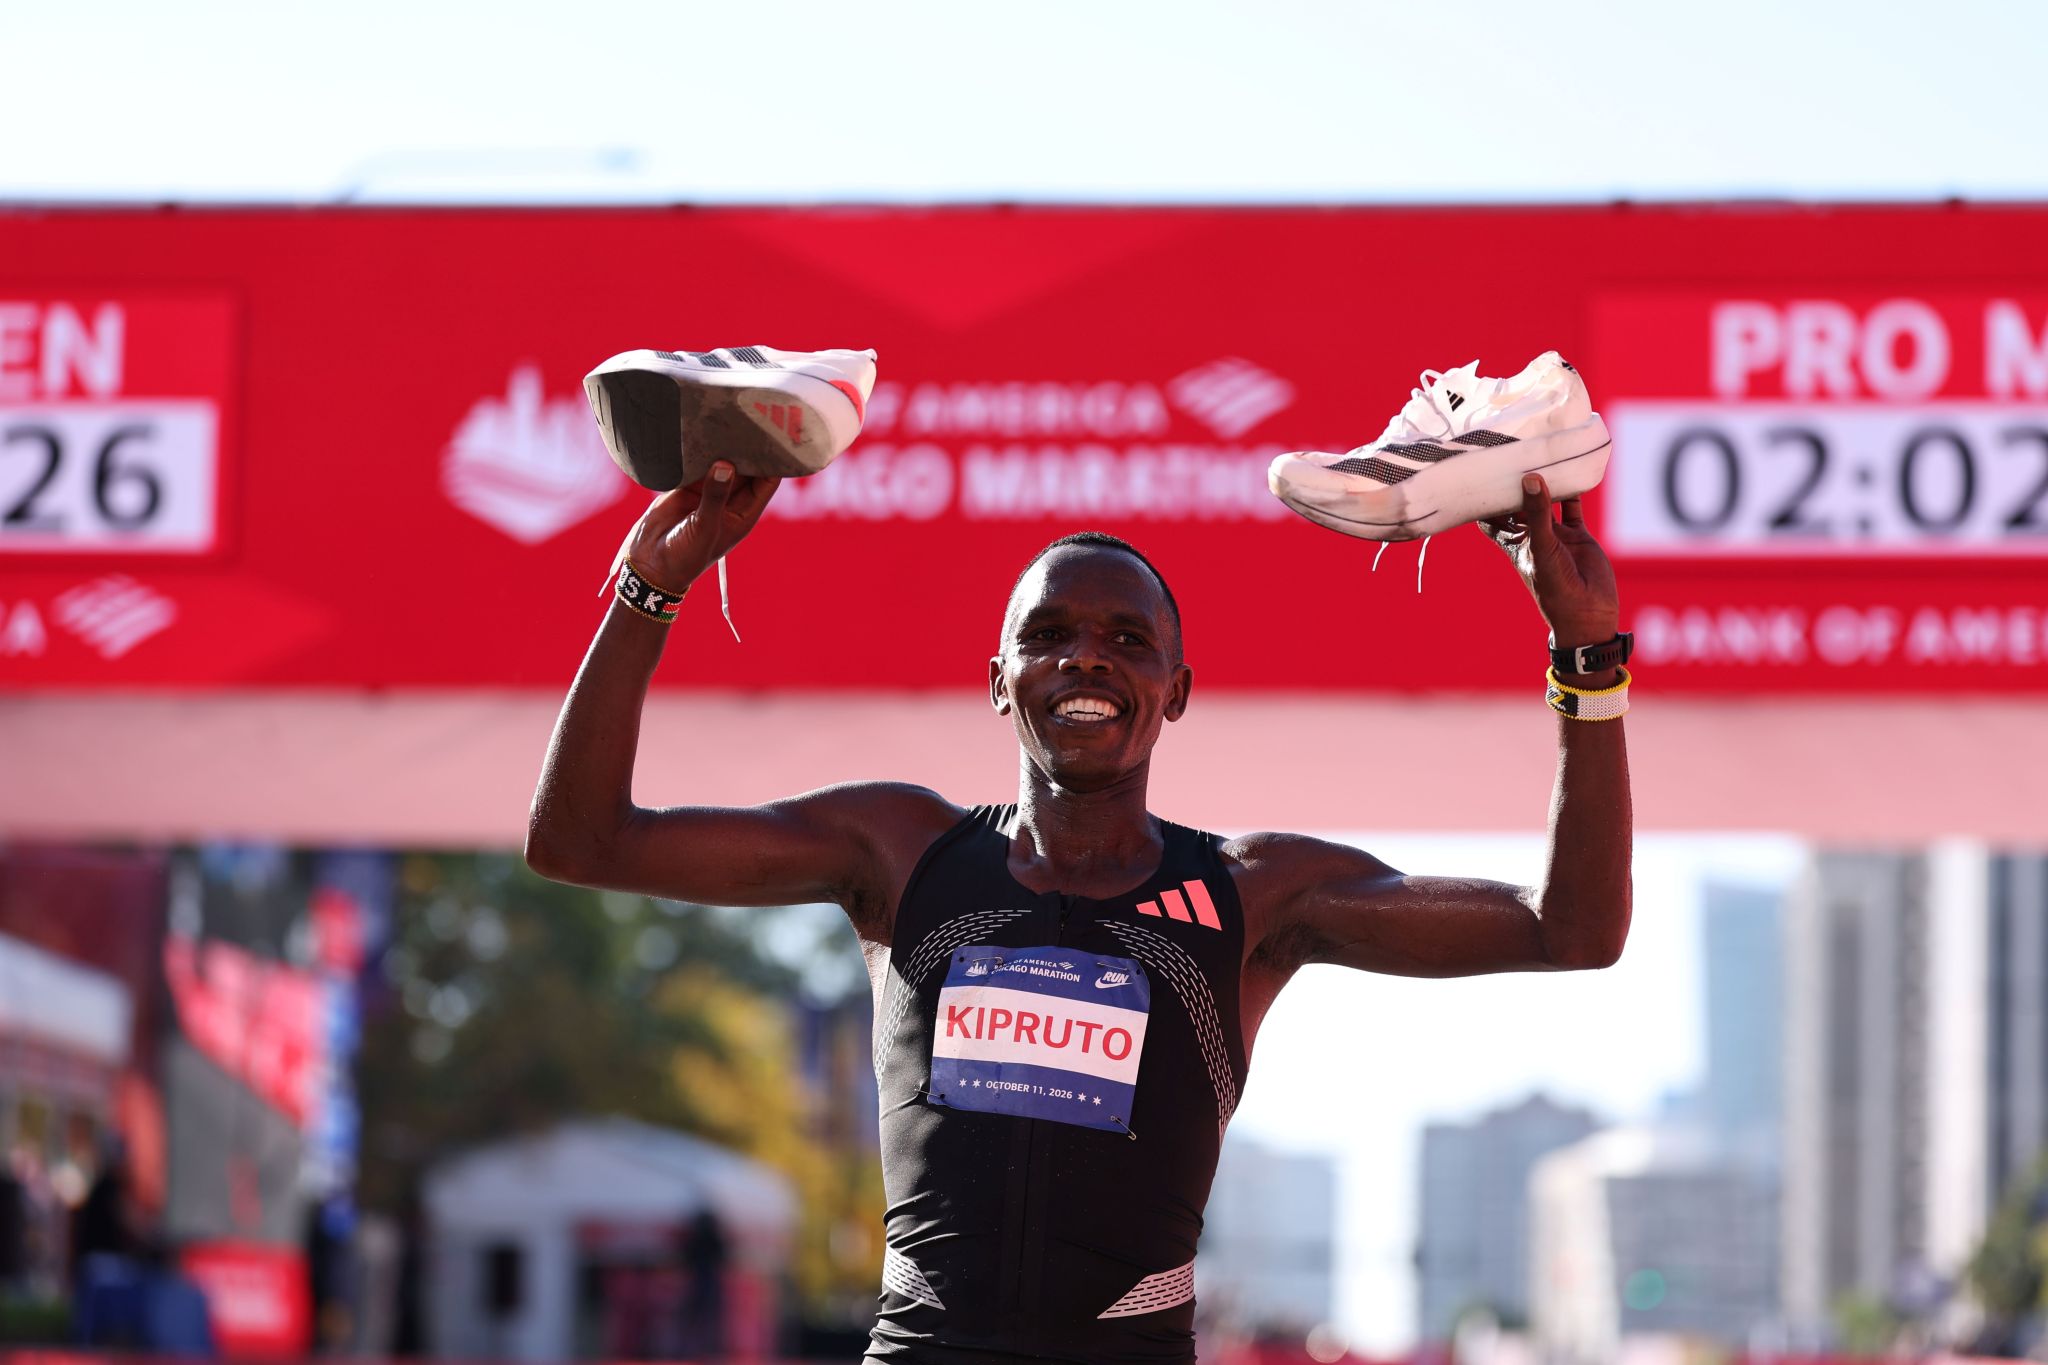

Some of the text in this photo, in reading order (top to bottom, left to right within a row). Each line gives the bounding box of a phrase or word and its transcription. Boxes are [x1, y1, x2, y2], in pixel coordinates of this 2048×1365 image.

[1711, 300, 1951, 400] PRO
[906, 380, 1168, 436] AMERICA
[3, 422, 164, 533] 26
[960, 442, 1280, 522] MARATH
[1662, 424, 2048, 534] 02:02
[1635, 604, 2048, 664] BANK OF AME
[1023, 958, 1057, 968] AMERICA
[1029, 966, 1081, 982] MARATHON
[1102, 971, 1129, 983] RUN
[946, 1005, 1132, 1060] KIPRUTO
[985, 1080, 1073, 1099] OCTOBER 11, 2026
